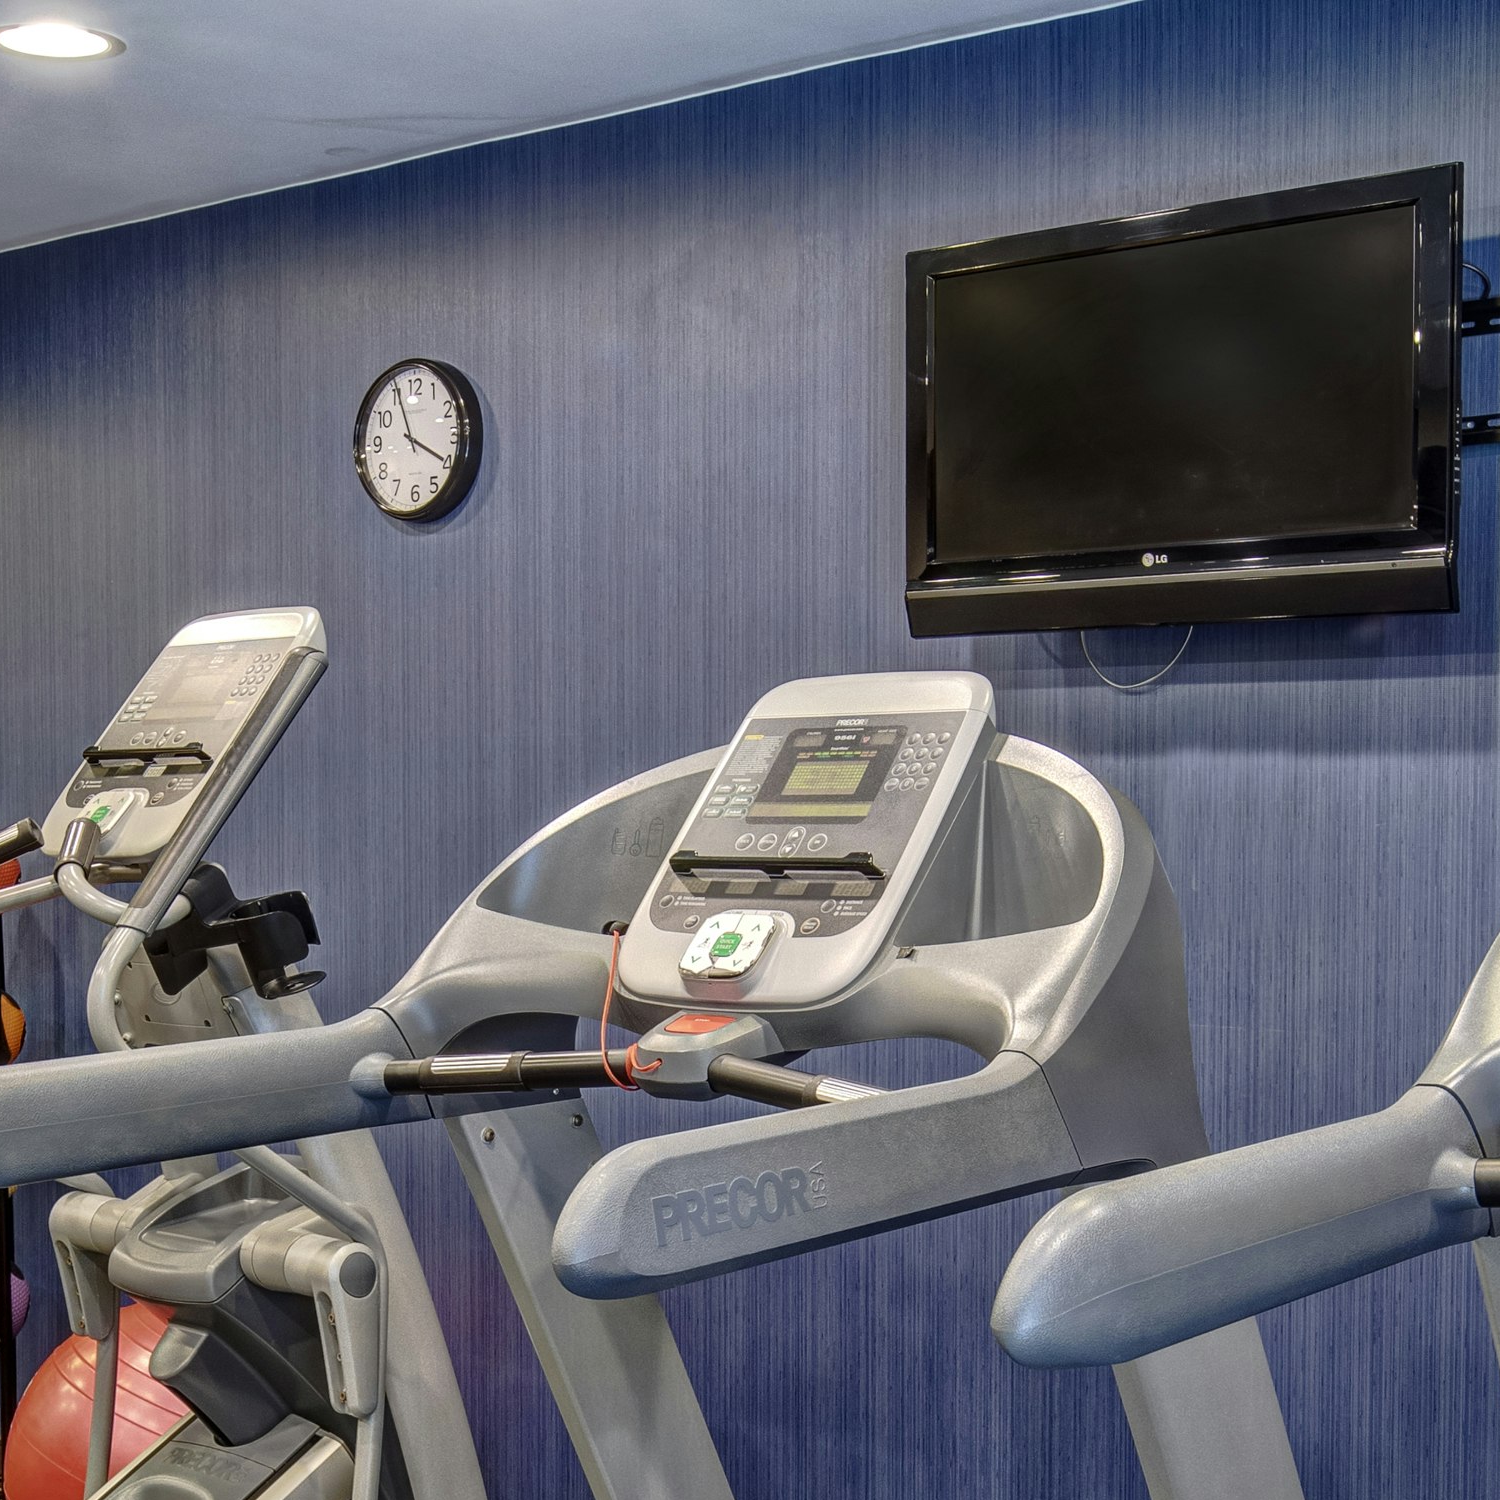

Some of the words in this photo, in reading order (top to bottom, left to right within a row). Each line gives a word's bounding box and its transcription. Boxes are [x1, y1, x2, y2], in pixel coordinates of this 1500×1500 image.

[408, 377, 423, 396] 12
[430, 382, 436, 400] 1
[443, 400, 453, 418] 2
[377, 410, 393, 429] 10
[373, 435, 382, 453] 9
[450, 426, 458, 445] 3
[378, 462, 388, 480] 8
[442, 454, 452, 470] 4
[392, 478, 401, 497] 7
[410, 484, 420, 503] 6
[429, 475, 439, 494] 5
[1155, 554, 1168, 564] LG
[835, 718, 866, 727] PRECOR
[650, 1166, 812, 1247] PRECOR
[811, 1160, 827, 1210] USA
